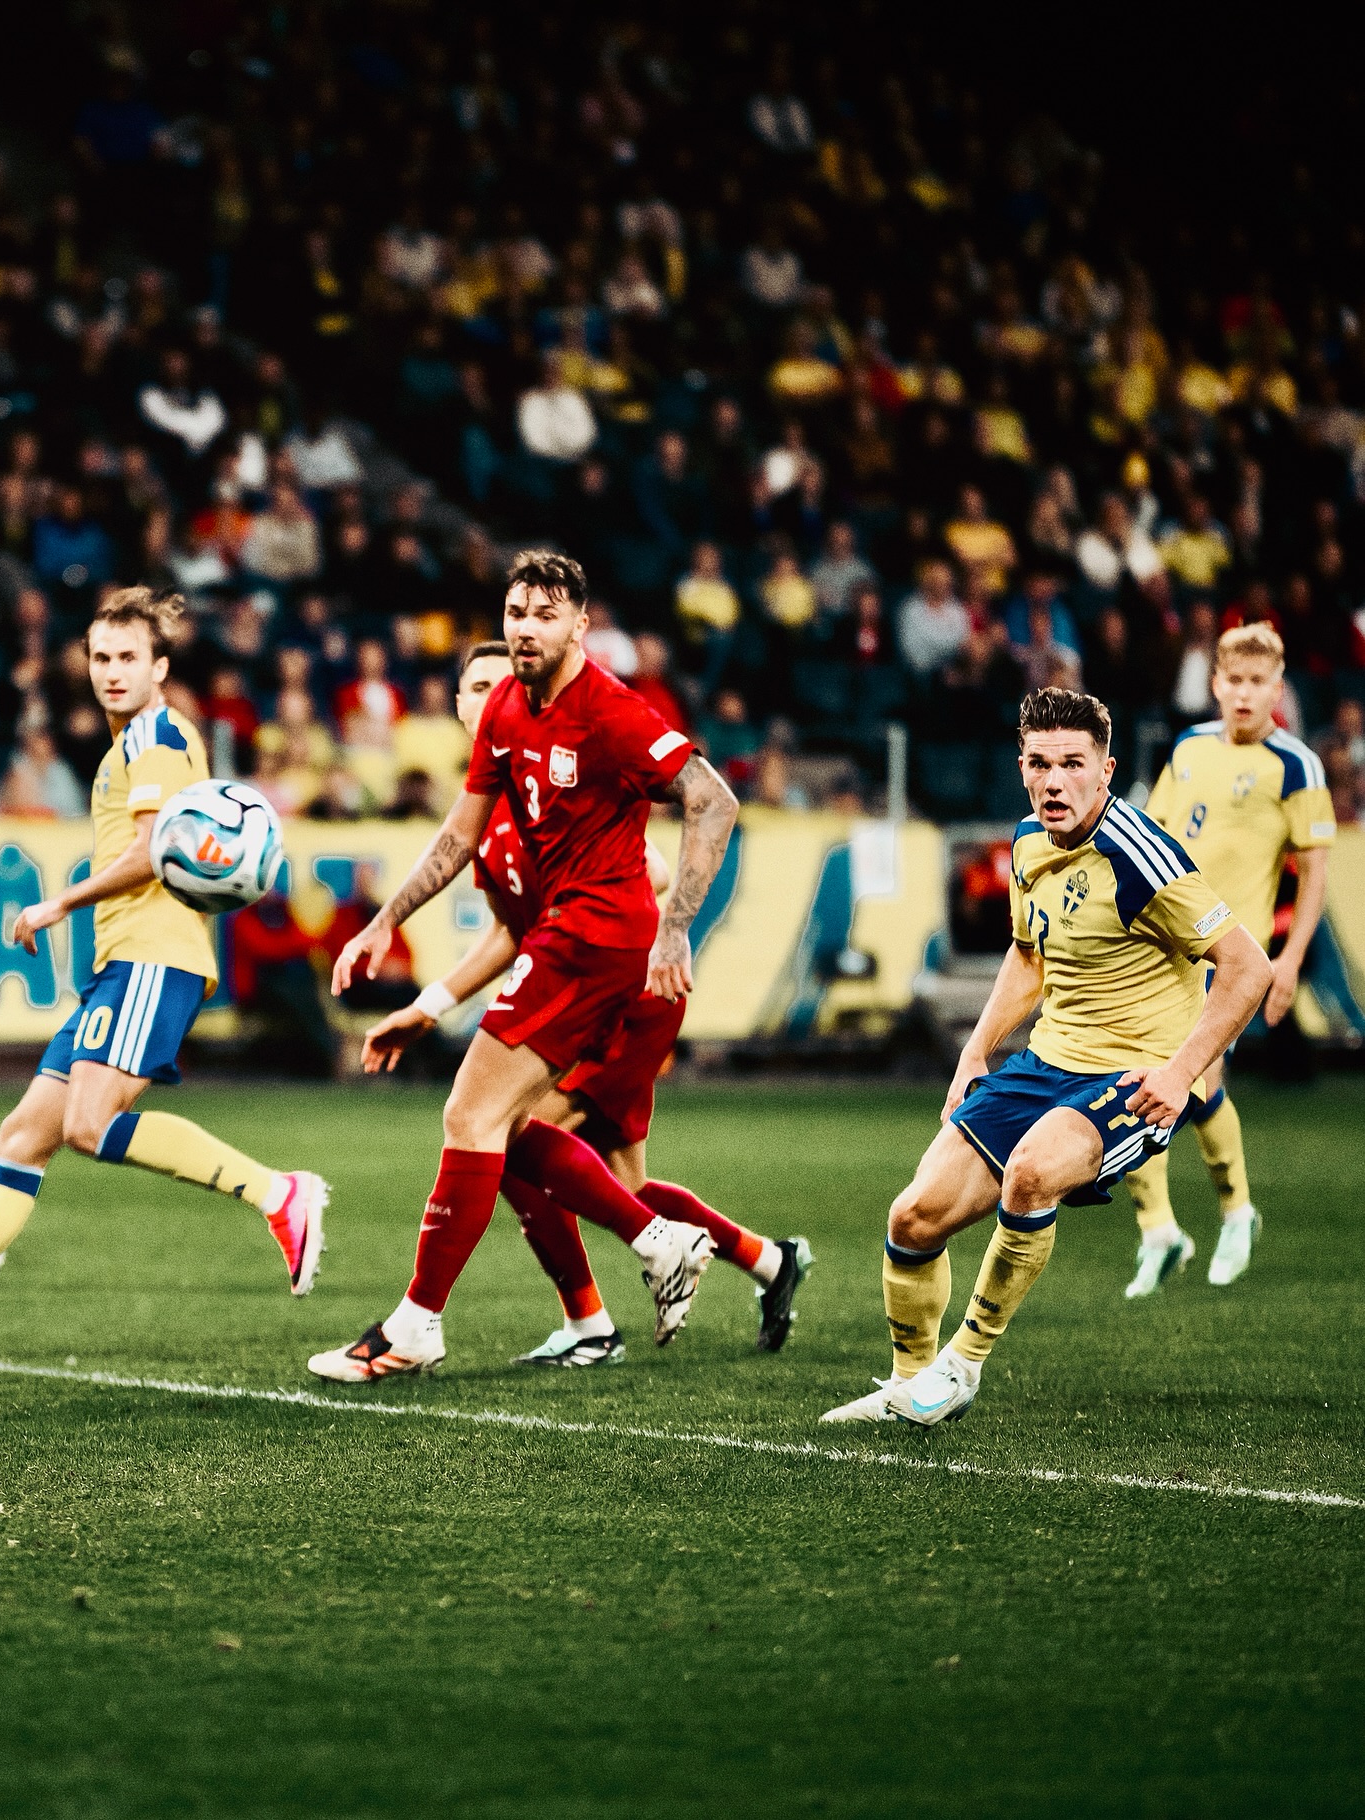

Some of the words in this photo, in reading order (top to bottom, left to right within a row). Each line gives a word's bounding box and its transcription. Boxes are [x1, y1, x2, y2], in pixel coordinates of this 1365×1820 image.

[524, 775, 541, 822] 3
[501, 953, 534, 997] 3
[73, 1005, 114, 1051] 10
